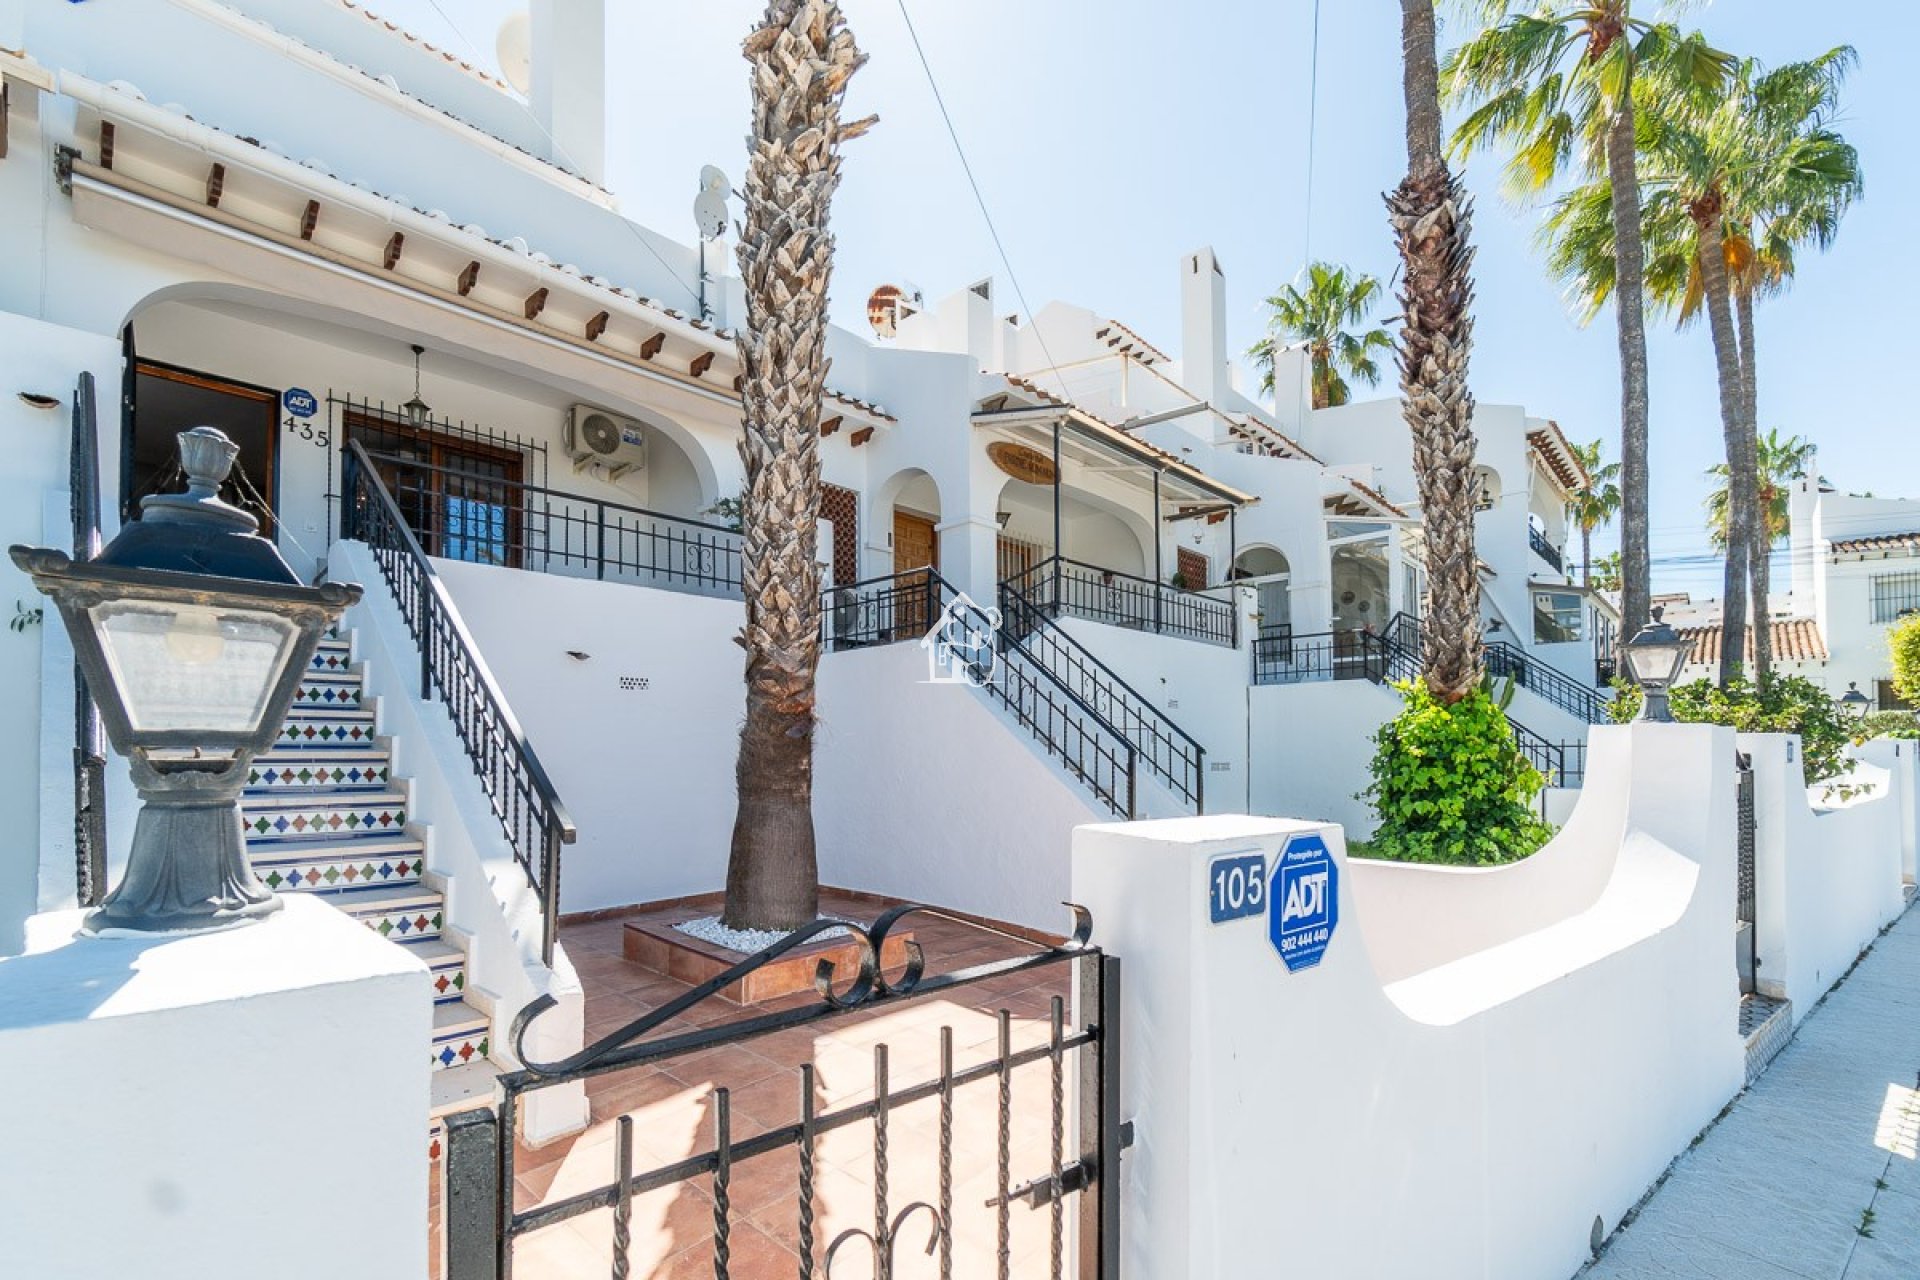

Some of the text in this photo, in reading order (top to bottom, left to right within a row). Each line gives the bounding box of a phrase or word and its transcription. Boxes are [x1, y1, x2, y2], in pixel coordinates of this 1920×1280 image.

[289, 396, 313, 409] ADT
[283, 416, 329, 447] 435
[1216, 864, 1262, 911] 105
[1283, 871, 1328, 923] ADT
[1281, 936, 1296, 952] 902
[1298, 932, 1312, 946] 444
